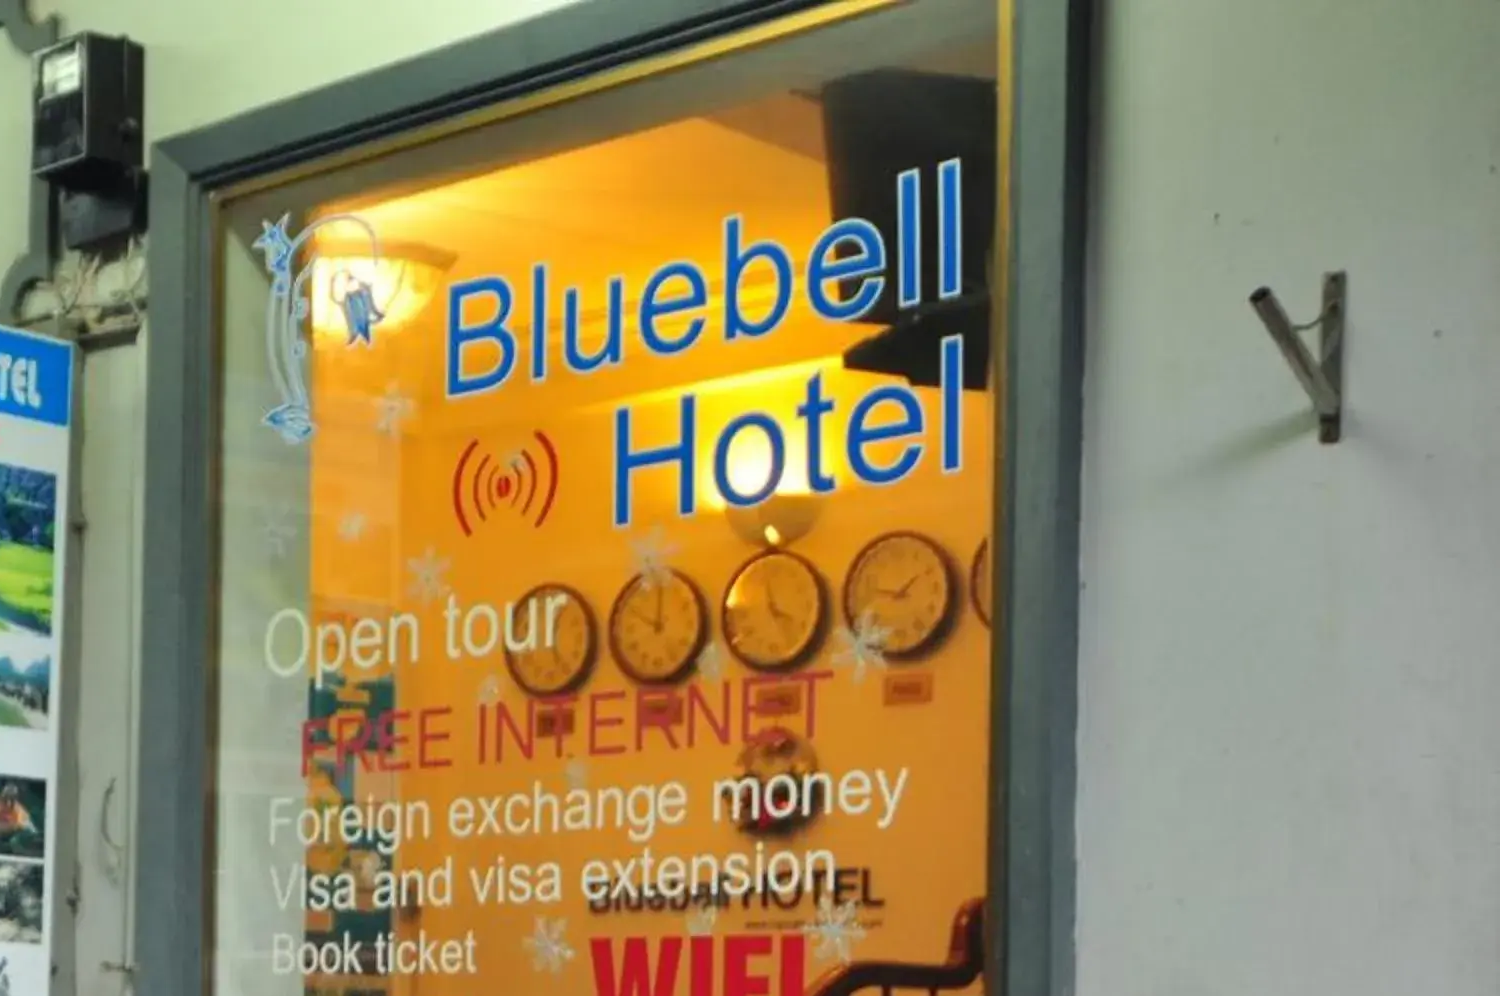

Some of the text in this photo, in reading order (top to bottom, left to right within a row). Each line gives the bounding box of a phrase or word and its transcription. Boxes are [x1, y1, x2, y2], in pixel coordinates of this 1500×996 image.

[445, 156, 963, 398] Bluebell
[613, 333, 965, 527] Hotel
[264, 592, 568, 690] Open tour
[301, 670, 834, 778] FREE INTERNET
[269, 767, 909, 855] Foreign exchange money
[270, 842, 836, 912] Visa and visa extension
[272, 929, 477, 975] Book ticket
